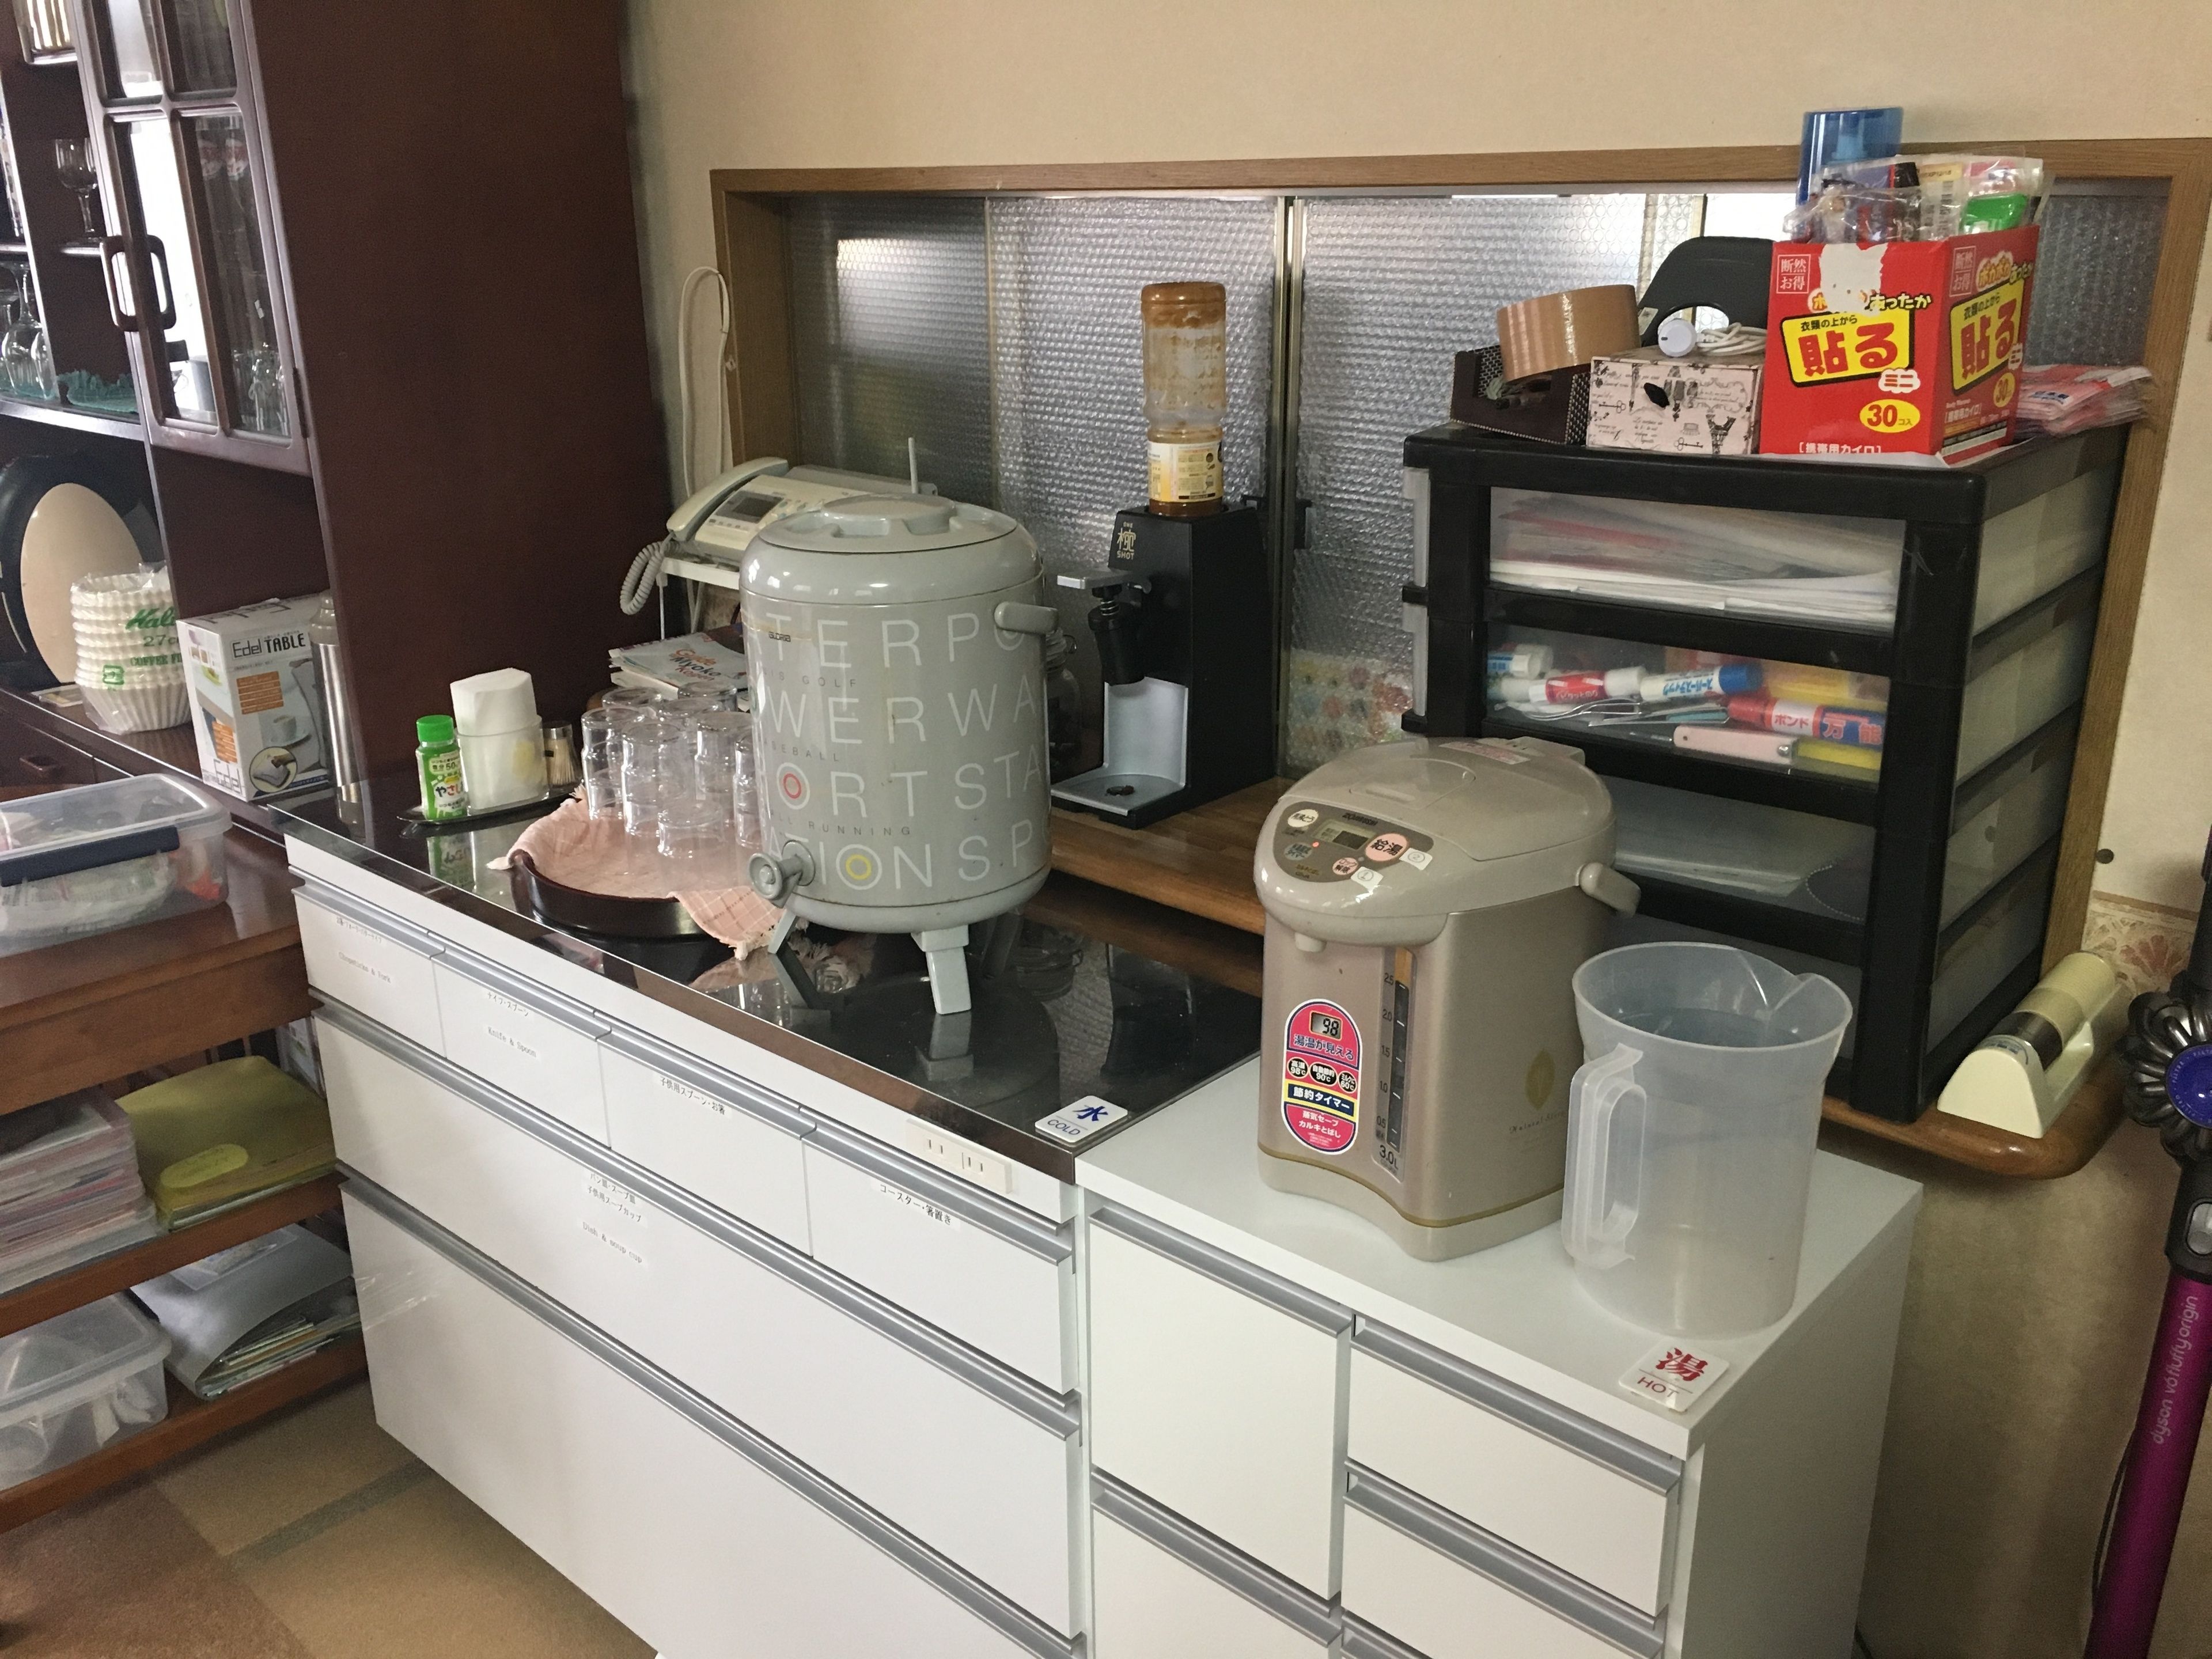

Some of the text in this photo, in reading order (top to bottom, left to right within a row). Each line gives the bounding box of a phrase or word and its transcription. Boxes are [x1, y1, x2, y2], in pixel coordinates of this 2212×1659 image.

[1781, 258, 1806, 274] 断然
[1779, 275, 1805, 290] お得
[1800, 315, 1858, 332] 衣類の上から
[1960, 297, 2017, 380] 貼る
[1797, 323, 1899, 377] 貼る
[1884, 374, 1914, 388] ミニ
[1116, 551, 1135, 560] SHOT
[232, 638, 262, 658] Edel
[264, 633, 306, 653] TABLE
[669, 656, 721, 676] Myoko
[676, 649, 717, 666] Guide
[802, 675, 857, 688] GOLF
[1775, 714, 1809, 728] ボンド
[1823, 718, 1883, 745] 万能
[808, 820, 911, 836] RUNNING
[1370, 839, 1404, 857] 給湯
[1322, 1018, 1339, 1036] 98
[488, 1027, 537, 1058] Knife & Spoon
[1294, 1035, 1354, 1060] 湯温が見える
[660, 1077, 725, 1115] 子供用スプーン・お箸
[1293, 1086, 1350, 1109] 節約タイマー
[1072, 1104, 1109, 1122] 水
[1047, 1119, 1081, 1135] COLD
[1298, 1120, 1341, 1138] カルキとばし
[880, 1184, 952, 1226] コースター・箸置き
[582, 1221, 643, 1263] Dish & soup cup
[1655, 1347, 1709, 1381] 湯
[2150, 1398, 2173, 1445] dyson
[2178, 1296, 2199, 1338] origin
[1637, 1377, 1680, 1398] HOT
